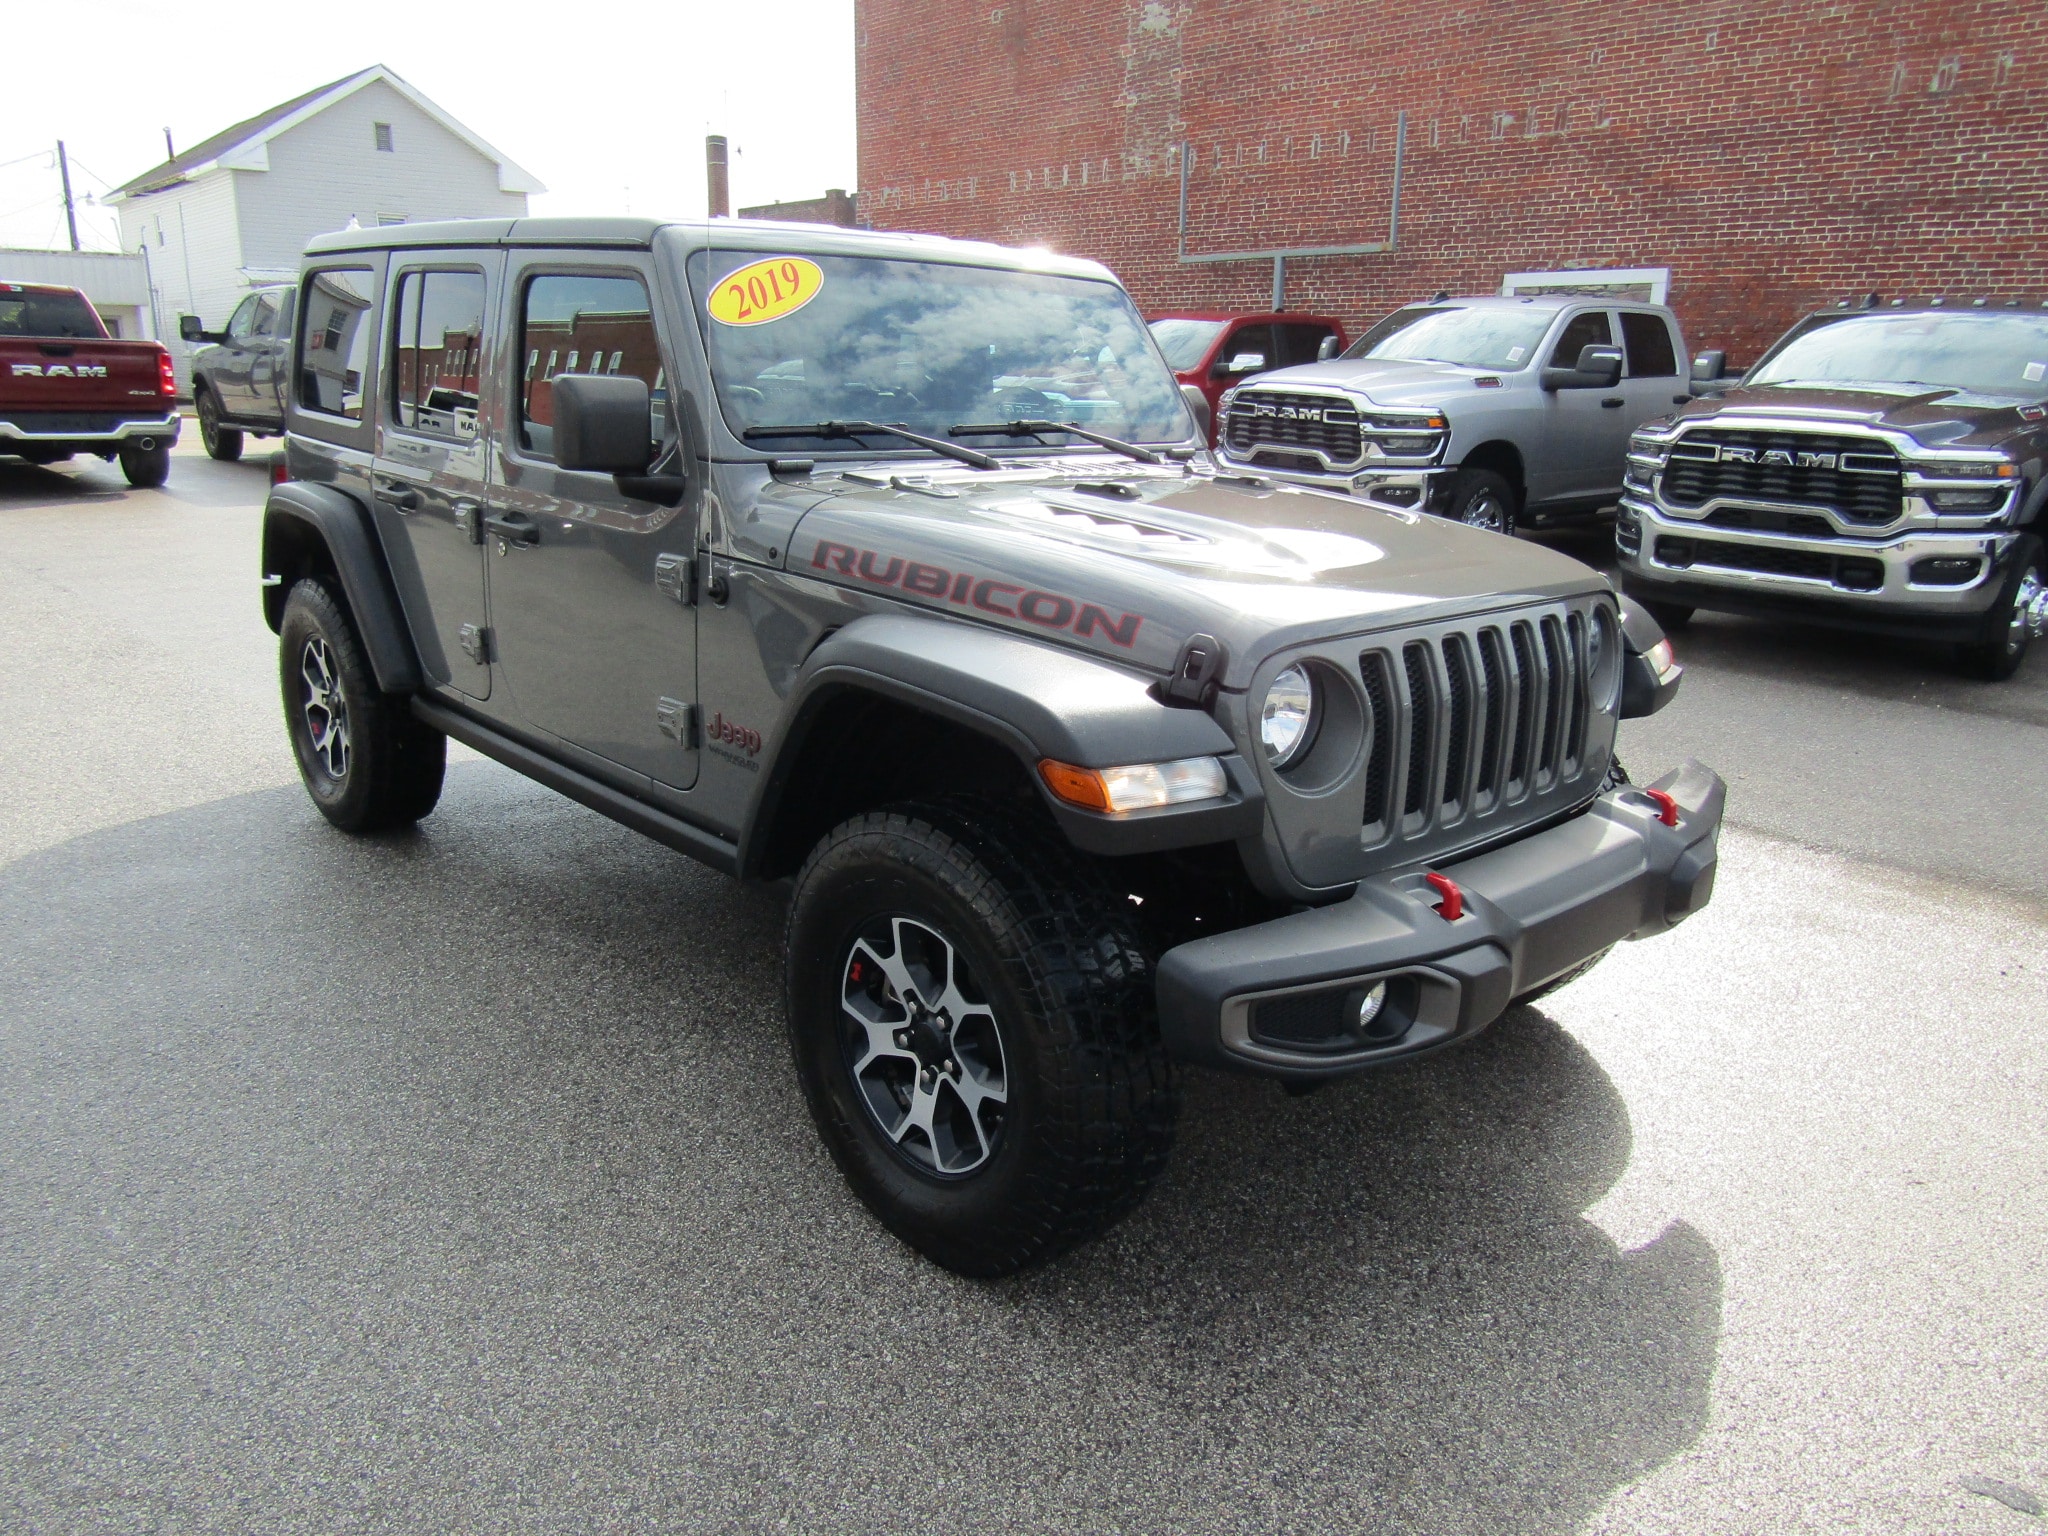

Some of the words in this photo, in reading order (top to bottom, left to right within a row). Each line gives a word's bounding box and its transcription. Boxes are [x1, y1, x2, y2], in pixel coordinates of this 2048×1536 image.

[728, 261, 800, 320] 2019
[10, 364, 108, 378] RAM
[1256, 405, 1321, 421] RAM
[1720, 446, 1837, 470] RAM
[811, 539, 1144, 648] RUBICON
[706, 711, 761, 757] Jeep
